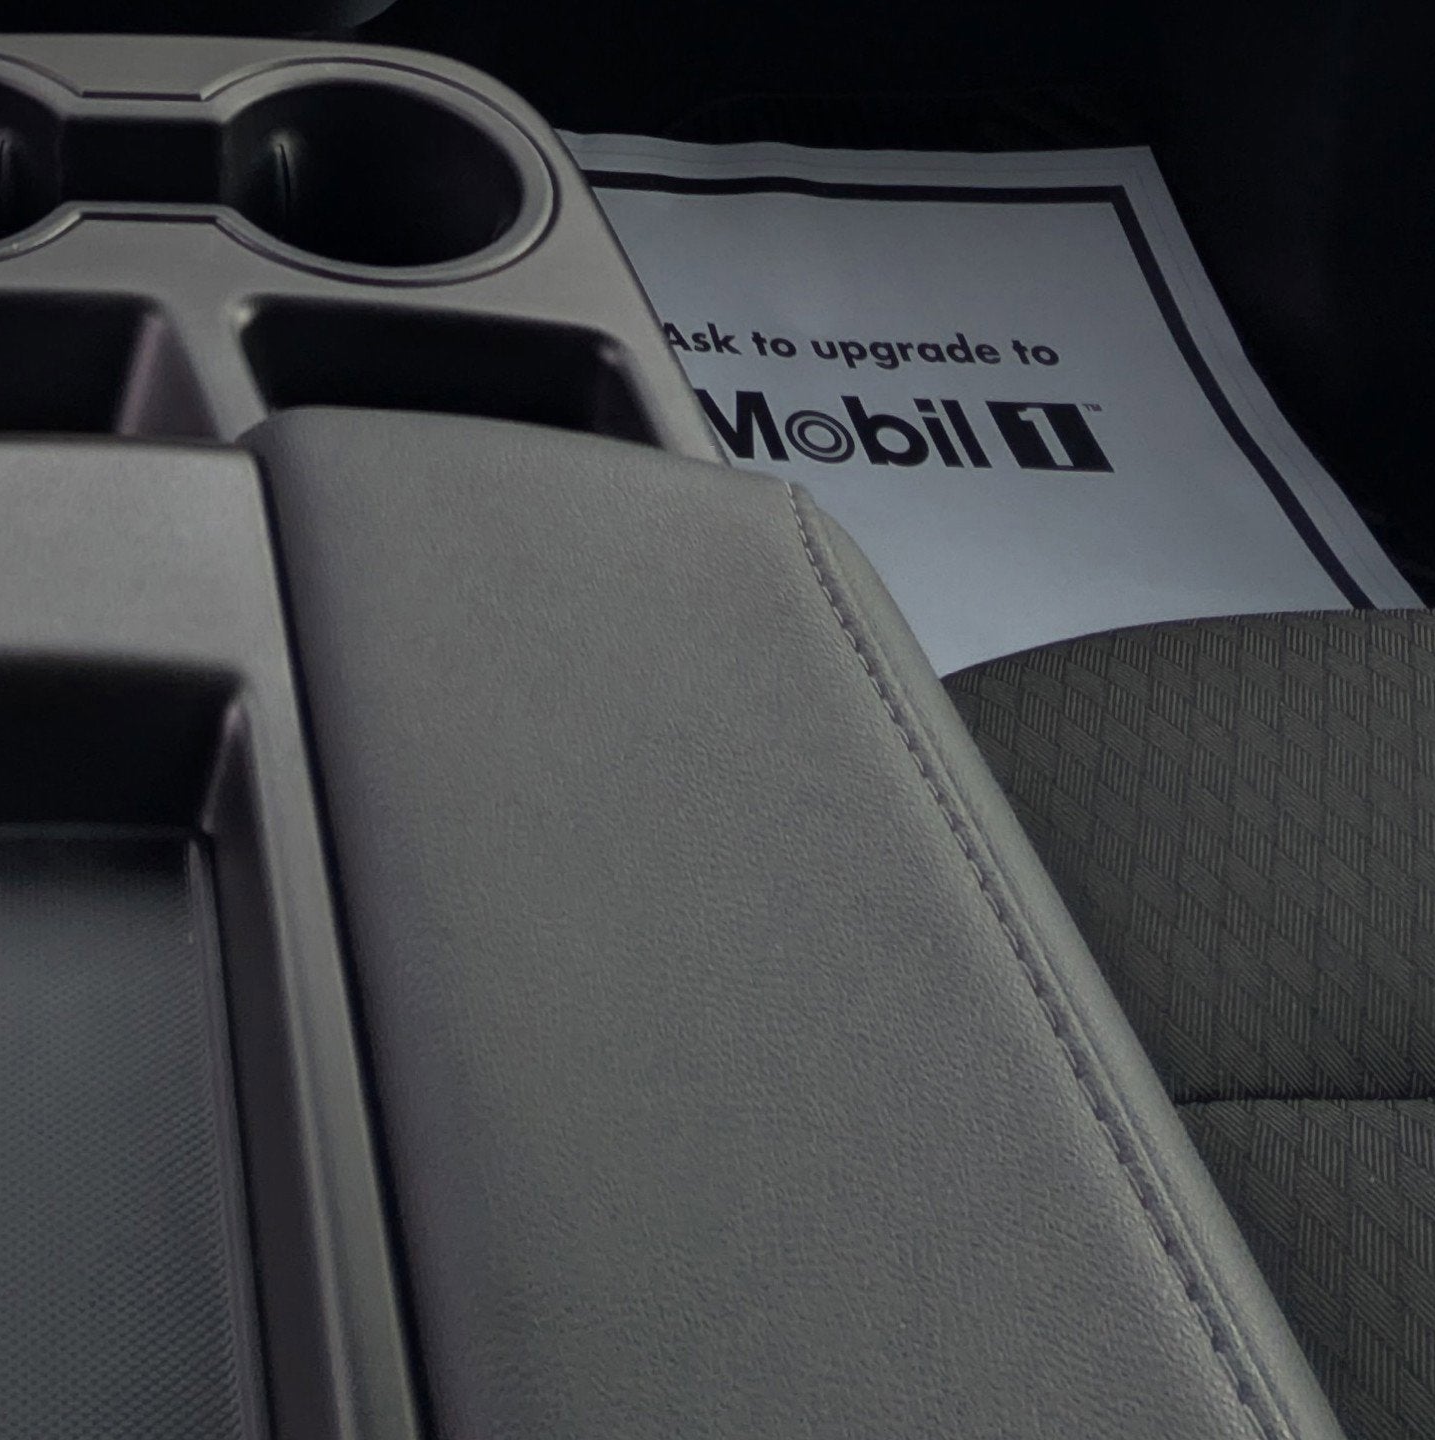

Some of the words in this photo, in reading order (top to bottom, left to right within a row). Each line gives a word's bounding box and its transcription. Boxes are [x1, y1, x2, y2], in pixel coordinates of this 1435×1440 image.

[662, 322, 738, 356] Ask
[751, 331, 797, 360] to
[810, 333, 1001, 371] upgrade
[1011, 338, 1060, 368] to
[695, 390, 992, 469] Mobil
